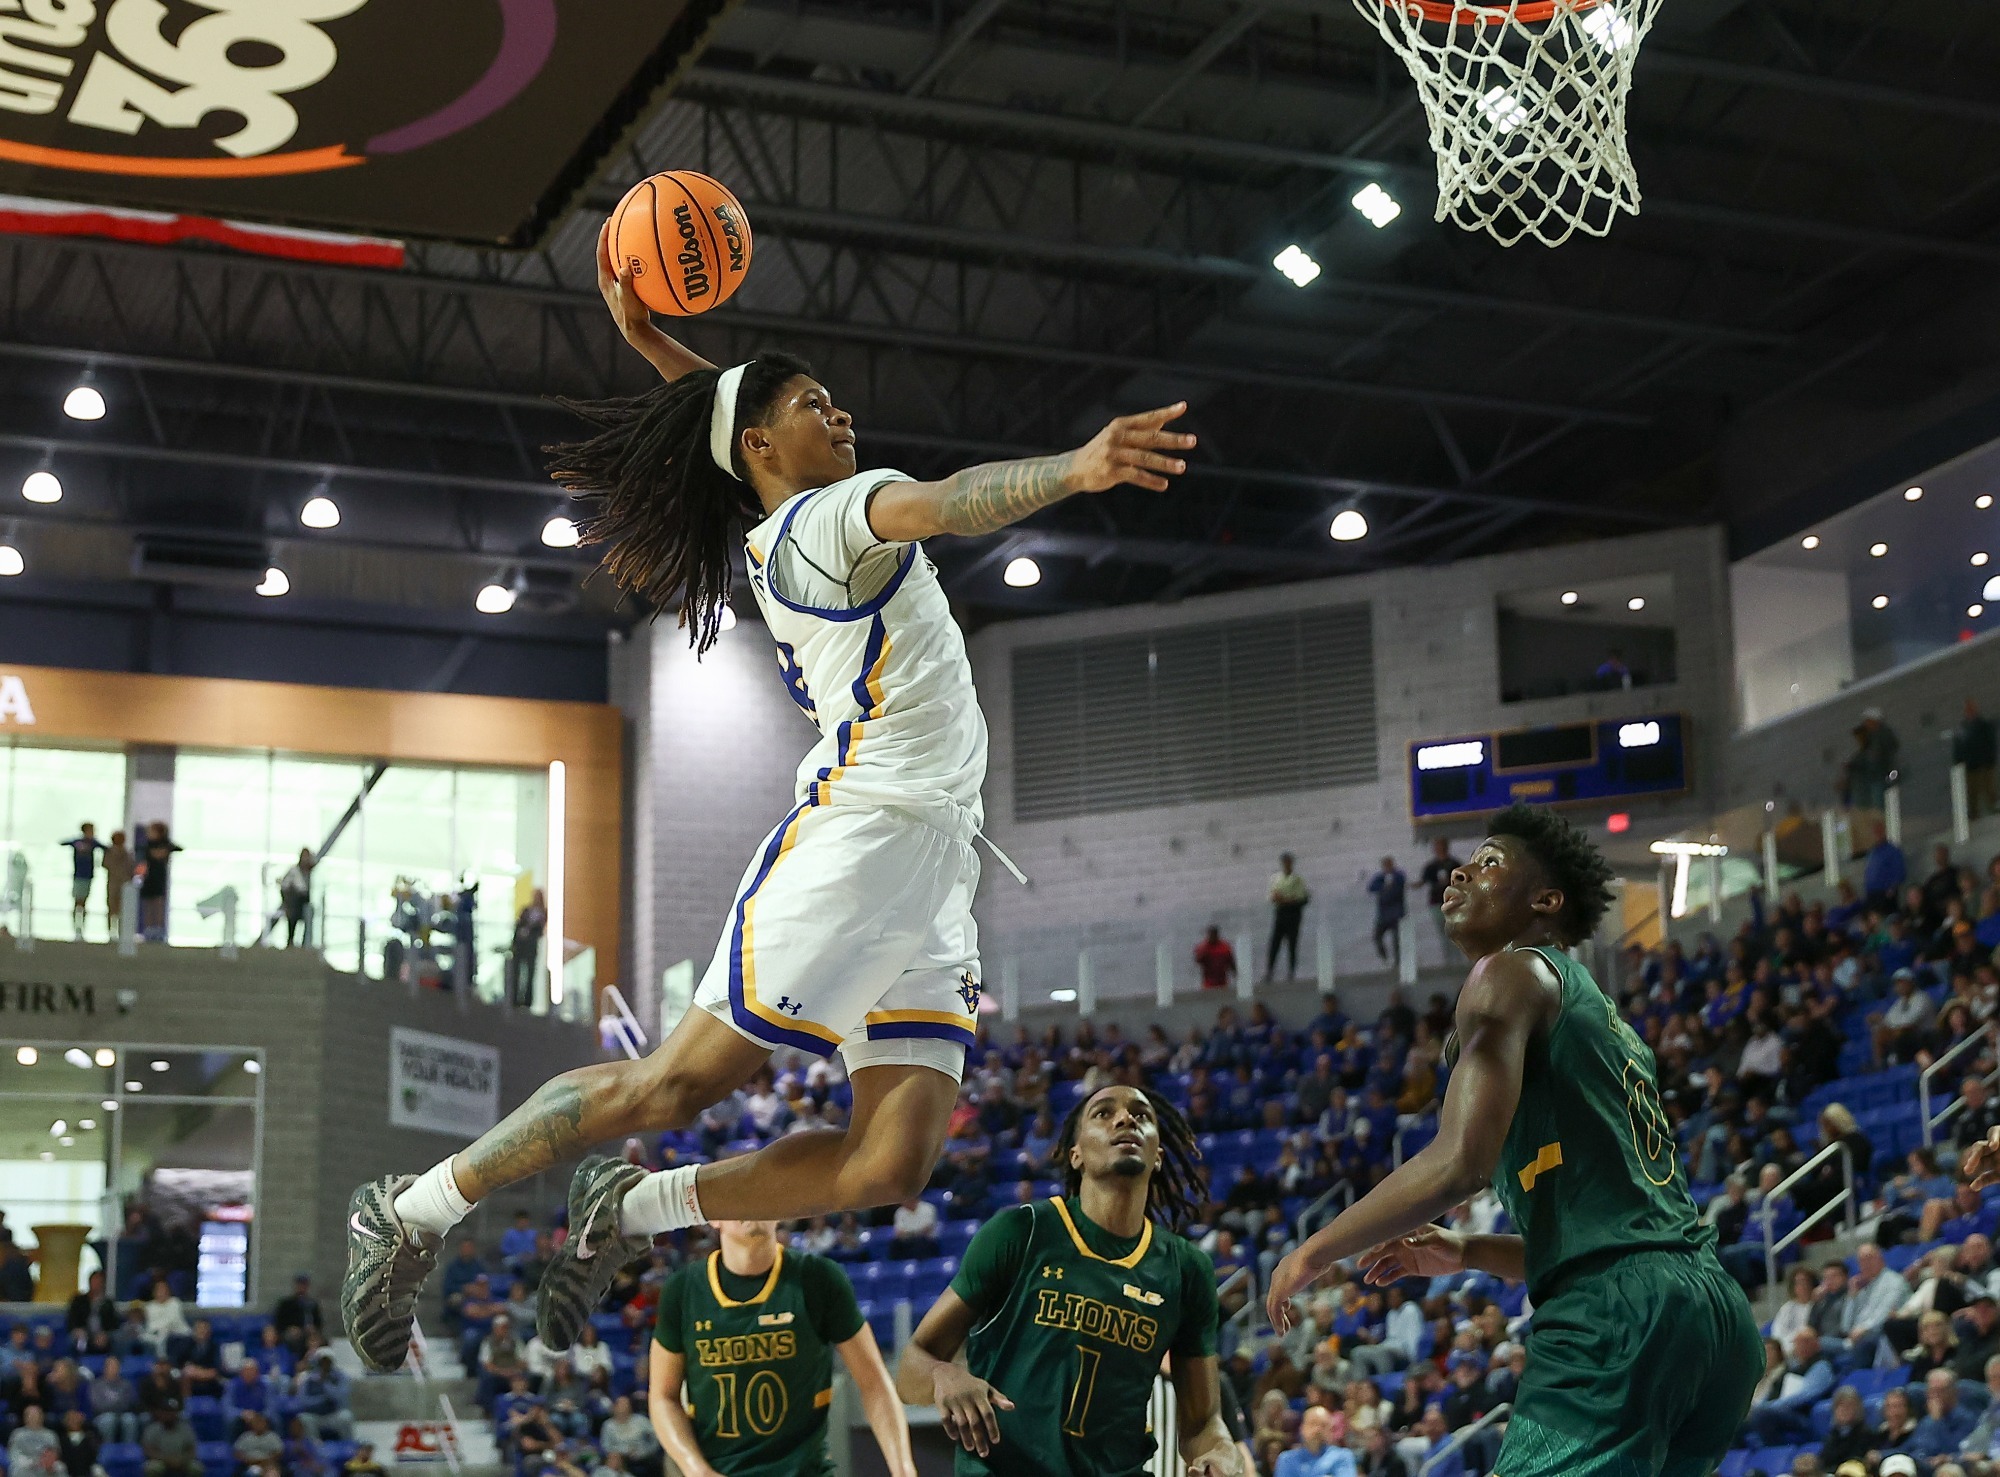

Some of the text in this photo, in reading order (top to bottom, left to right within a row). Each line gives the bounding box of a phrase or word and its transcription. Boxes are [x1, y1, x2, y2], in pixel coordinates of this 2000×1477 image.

[67, 0, 371, 158] 36
[672, 203, 711, 301] Wilson
[713, 203, 744, 272] NCAA
[695, 1330, 797, 1367] LIONS
[1034, 1289, 1159, 1353] LIONS
[711, 1370, 789, 1438] 10
[1062, 1344, 1101, 1438] 1
